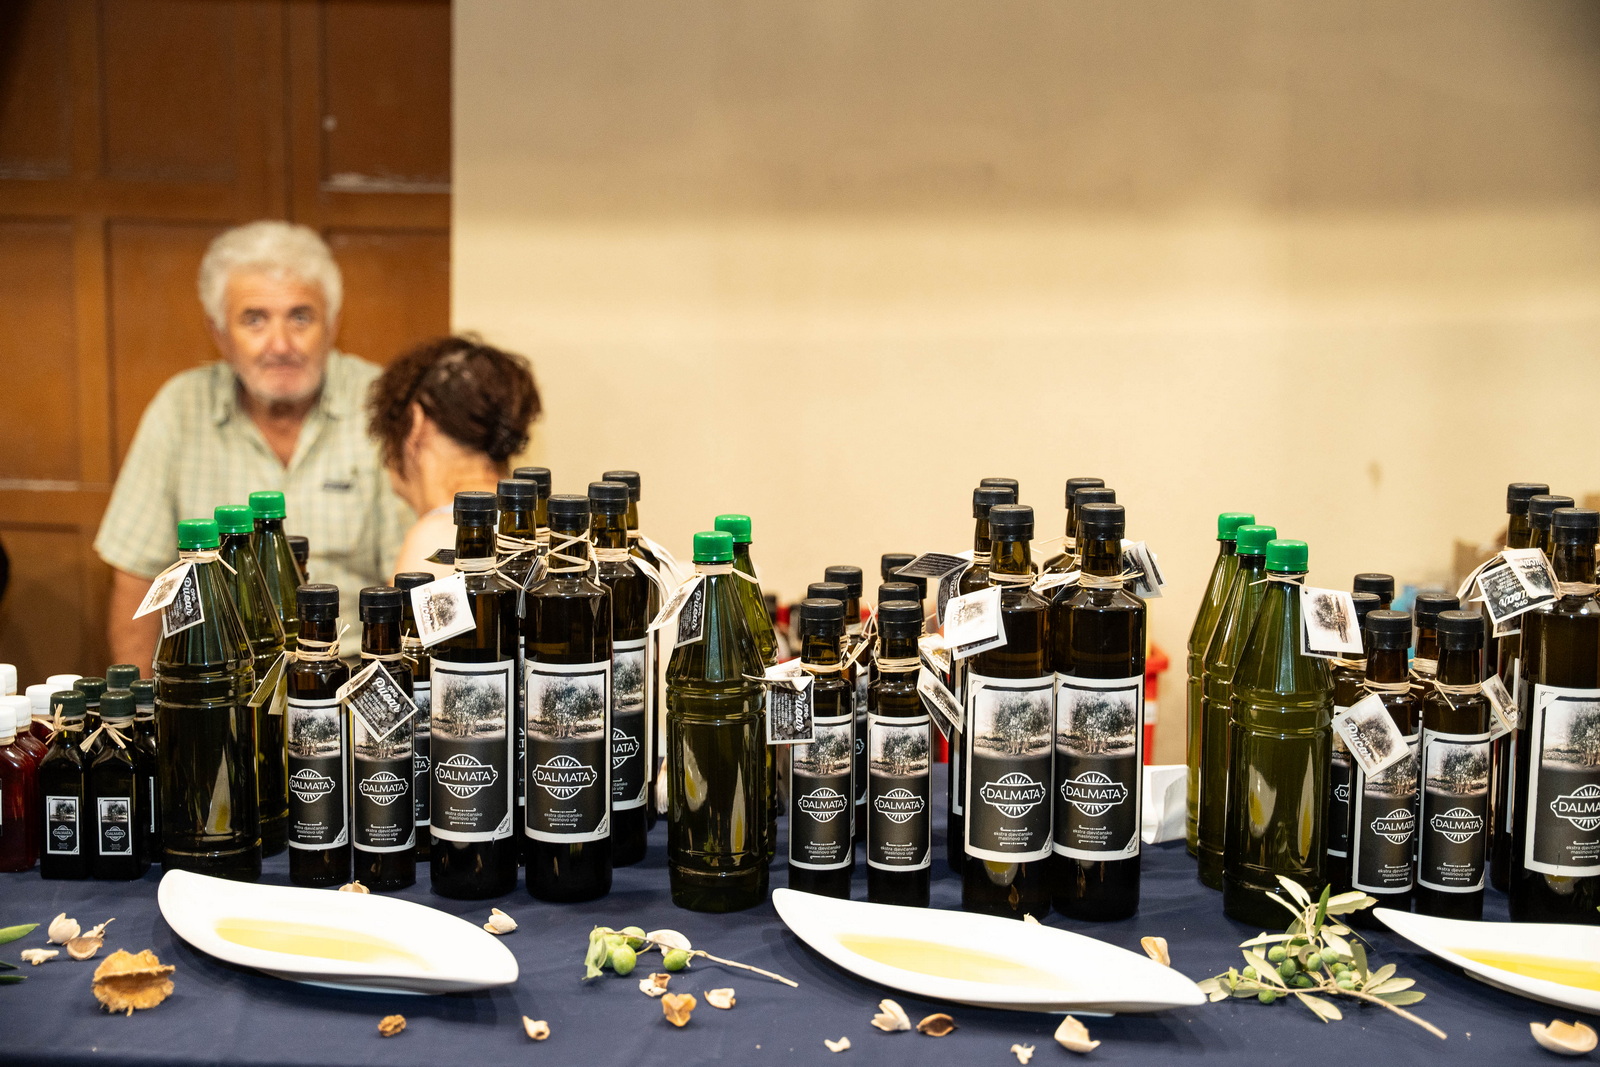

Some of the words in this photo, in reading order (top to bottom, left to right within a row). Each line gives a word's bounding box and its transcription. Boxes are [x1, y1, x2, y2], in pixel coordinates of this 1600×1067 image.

[1499, 590, 1528, 608] ucar
[439, 768, 491, 782] DALMATA
[537, 770, 591, 782] DALMATA
[291, 780, 330, 790] DALMATA
[362, 783, 404, 793] DALMATA
[986, 788, 1040, 800] DALMATA
[1066, 786, 1121, 799] DALMATA
[802, 799, 844, 809] DALMATA
[878, 800, 920, 810] DALMATA
[1559, 802, 1600, 813] DALMA
[1377, 820, 1414, 831] DALMATA
[1436, 818, 1479, 829] DALMATA
